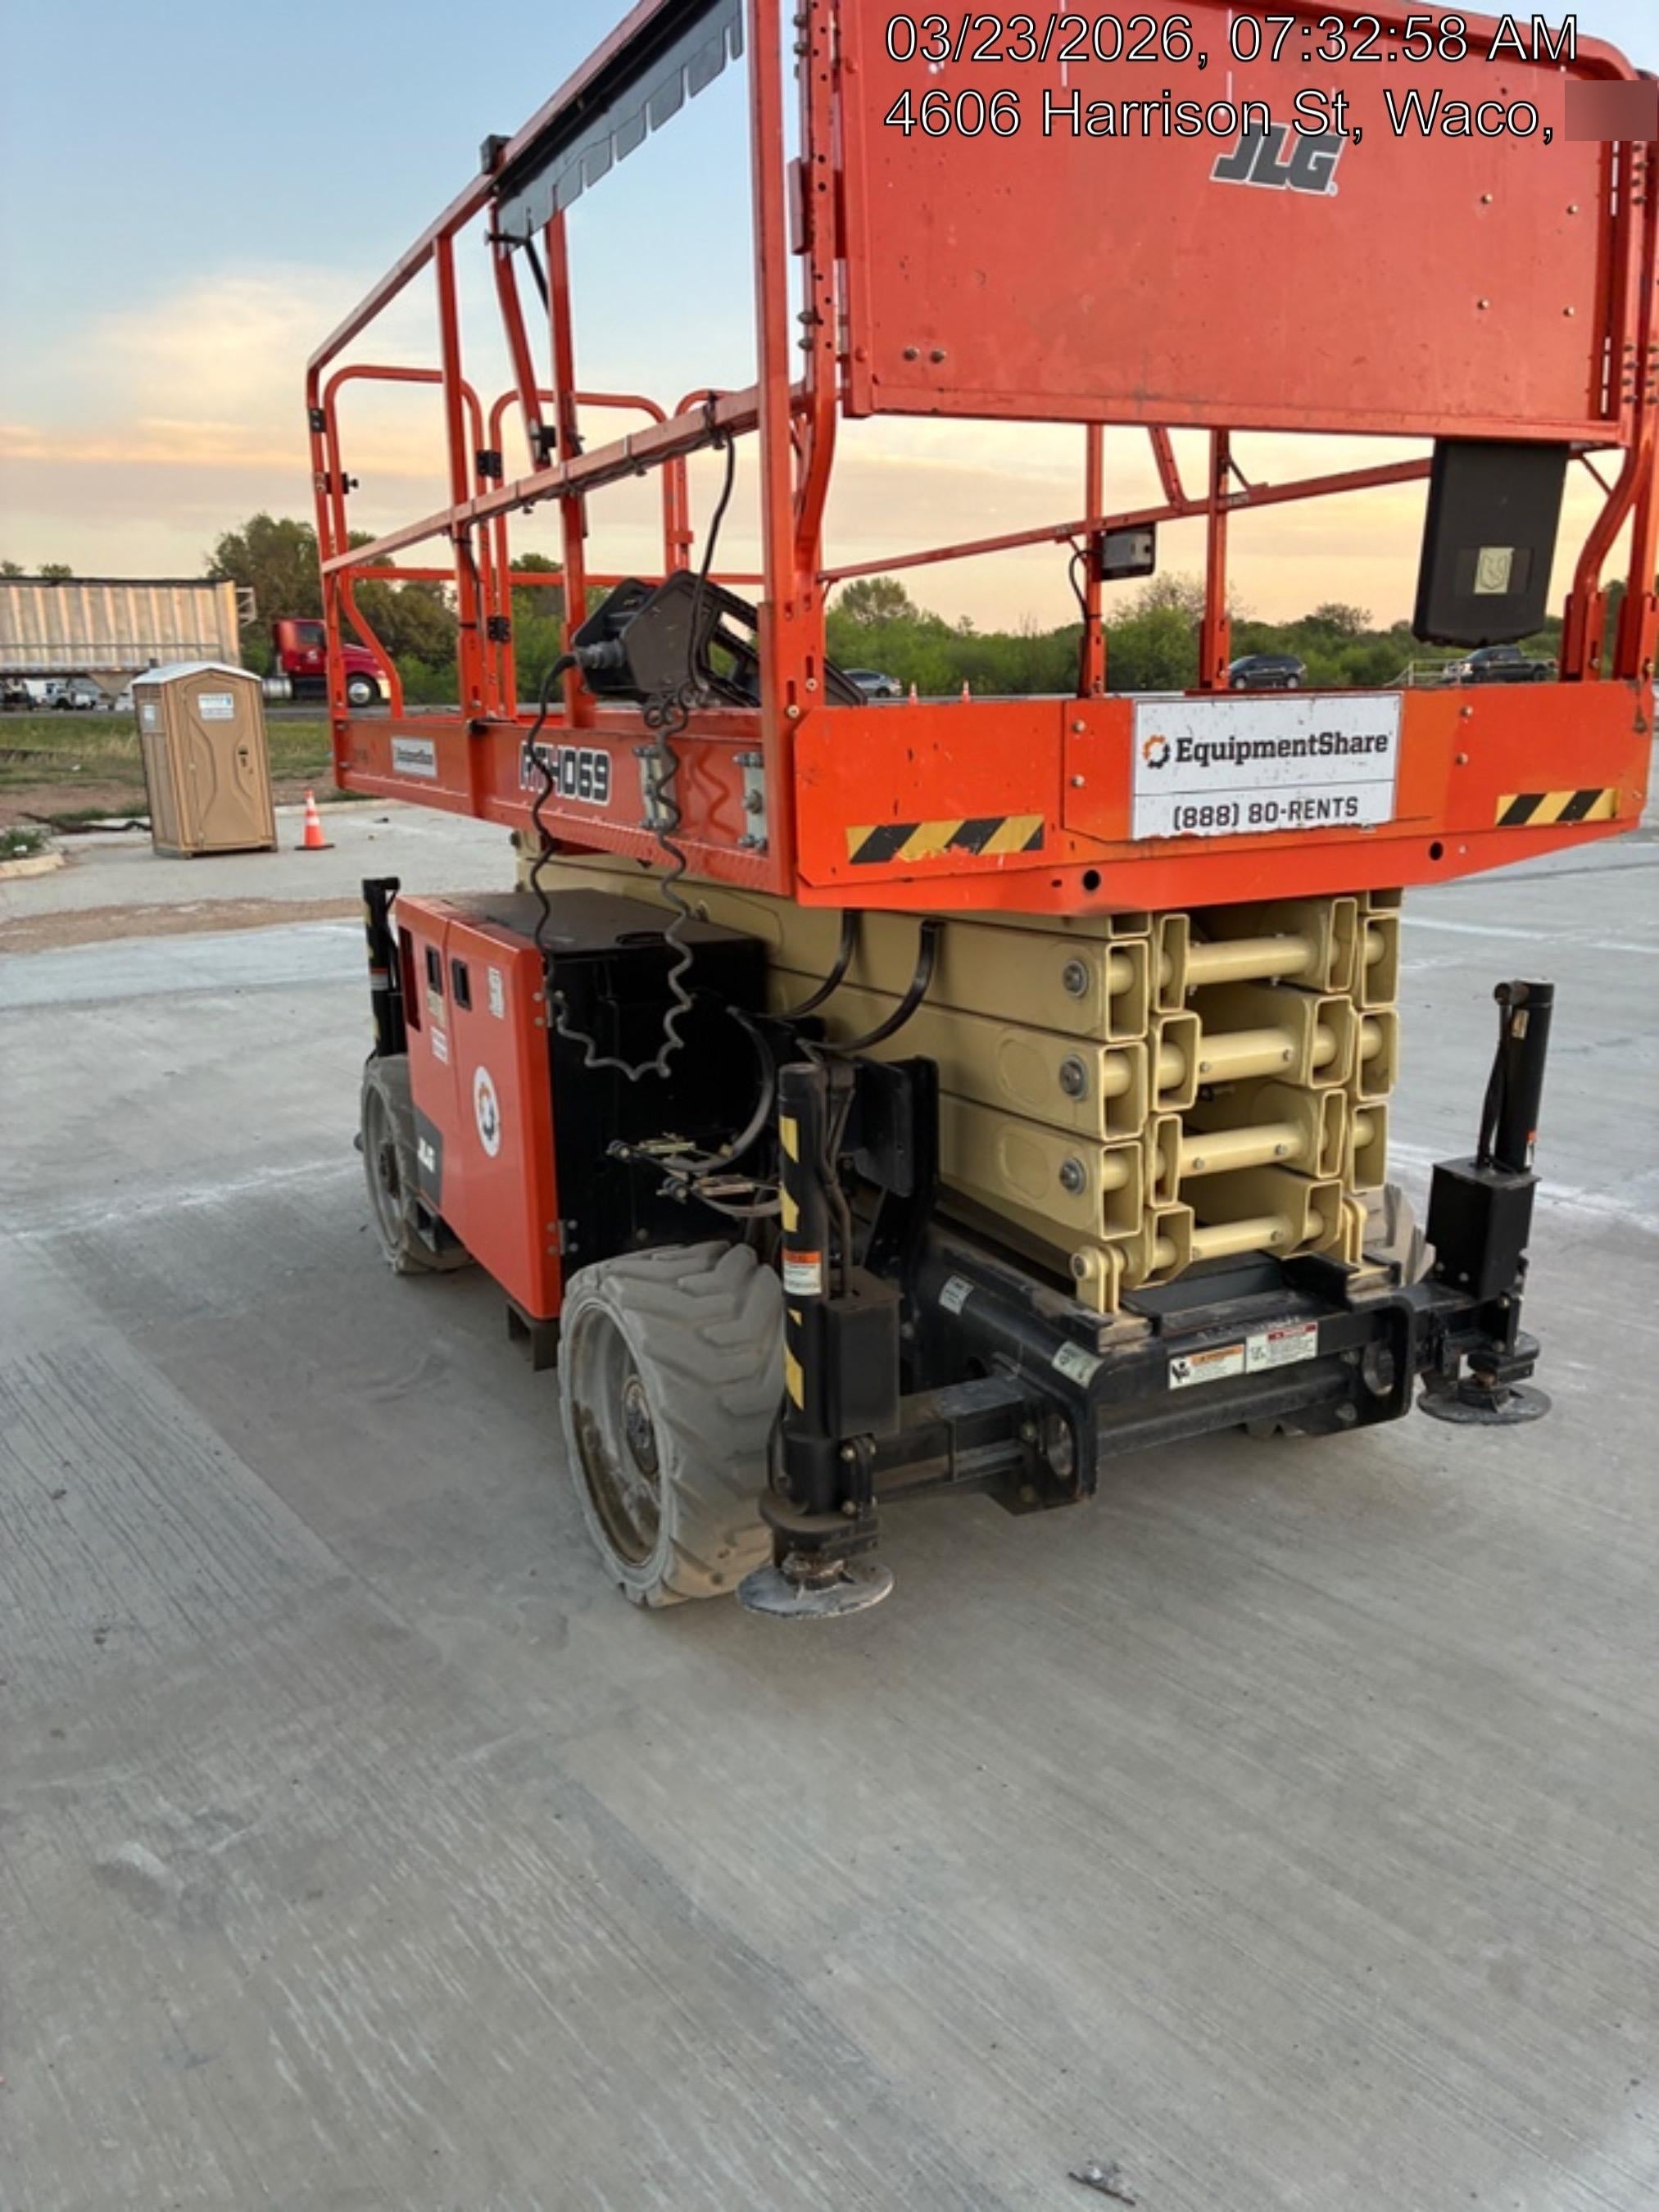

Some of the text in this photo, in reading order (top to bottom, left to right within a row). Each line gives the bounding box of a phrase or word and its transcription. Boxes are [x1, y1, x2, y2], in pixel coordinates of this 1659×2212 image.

[1209, 118, 1346, 196] JLG
[1175, 732, 1389, 767] EquipmentShare
[1174, 796, 1359, 831] (888) 80-RENTS
